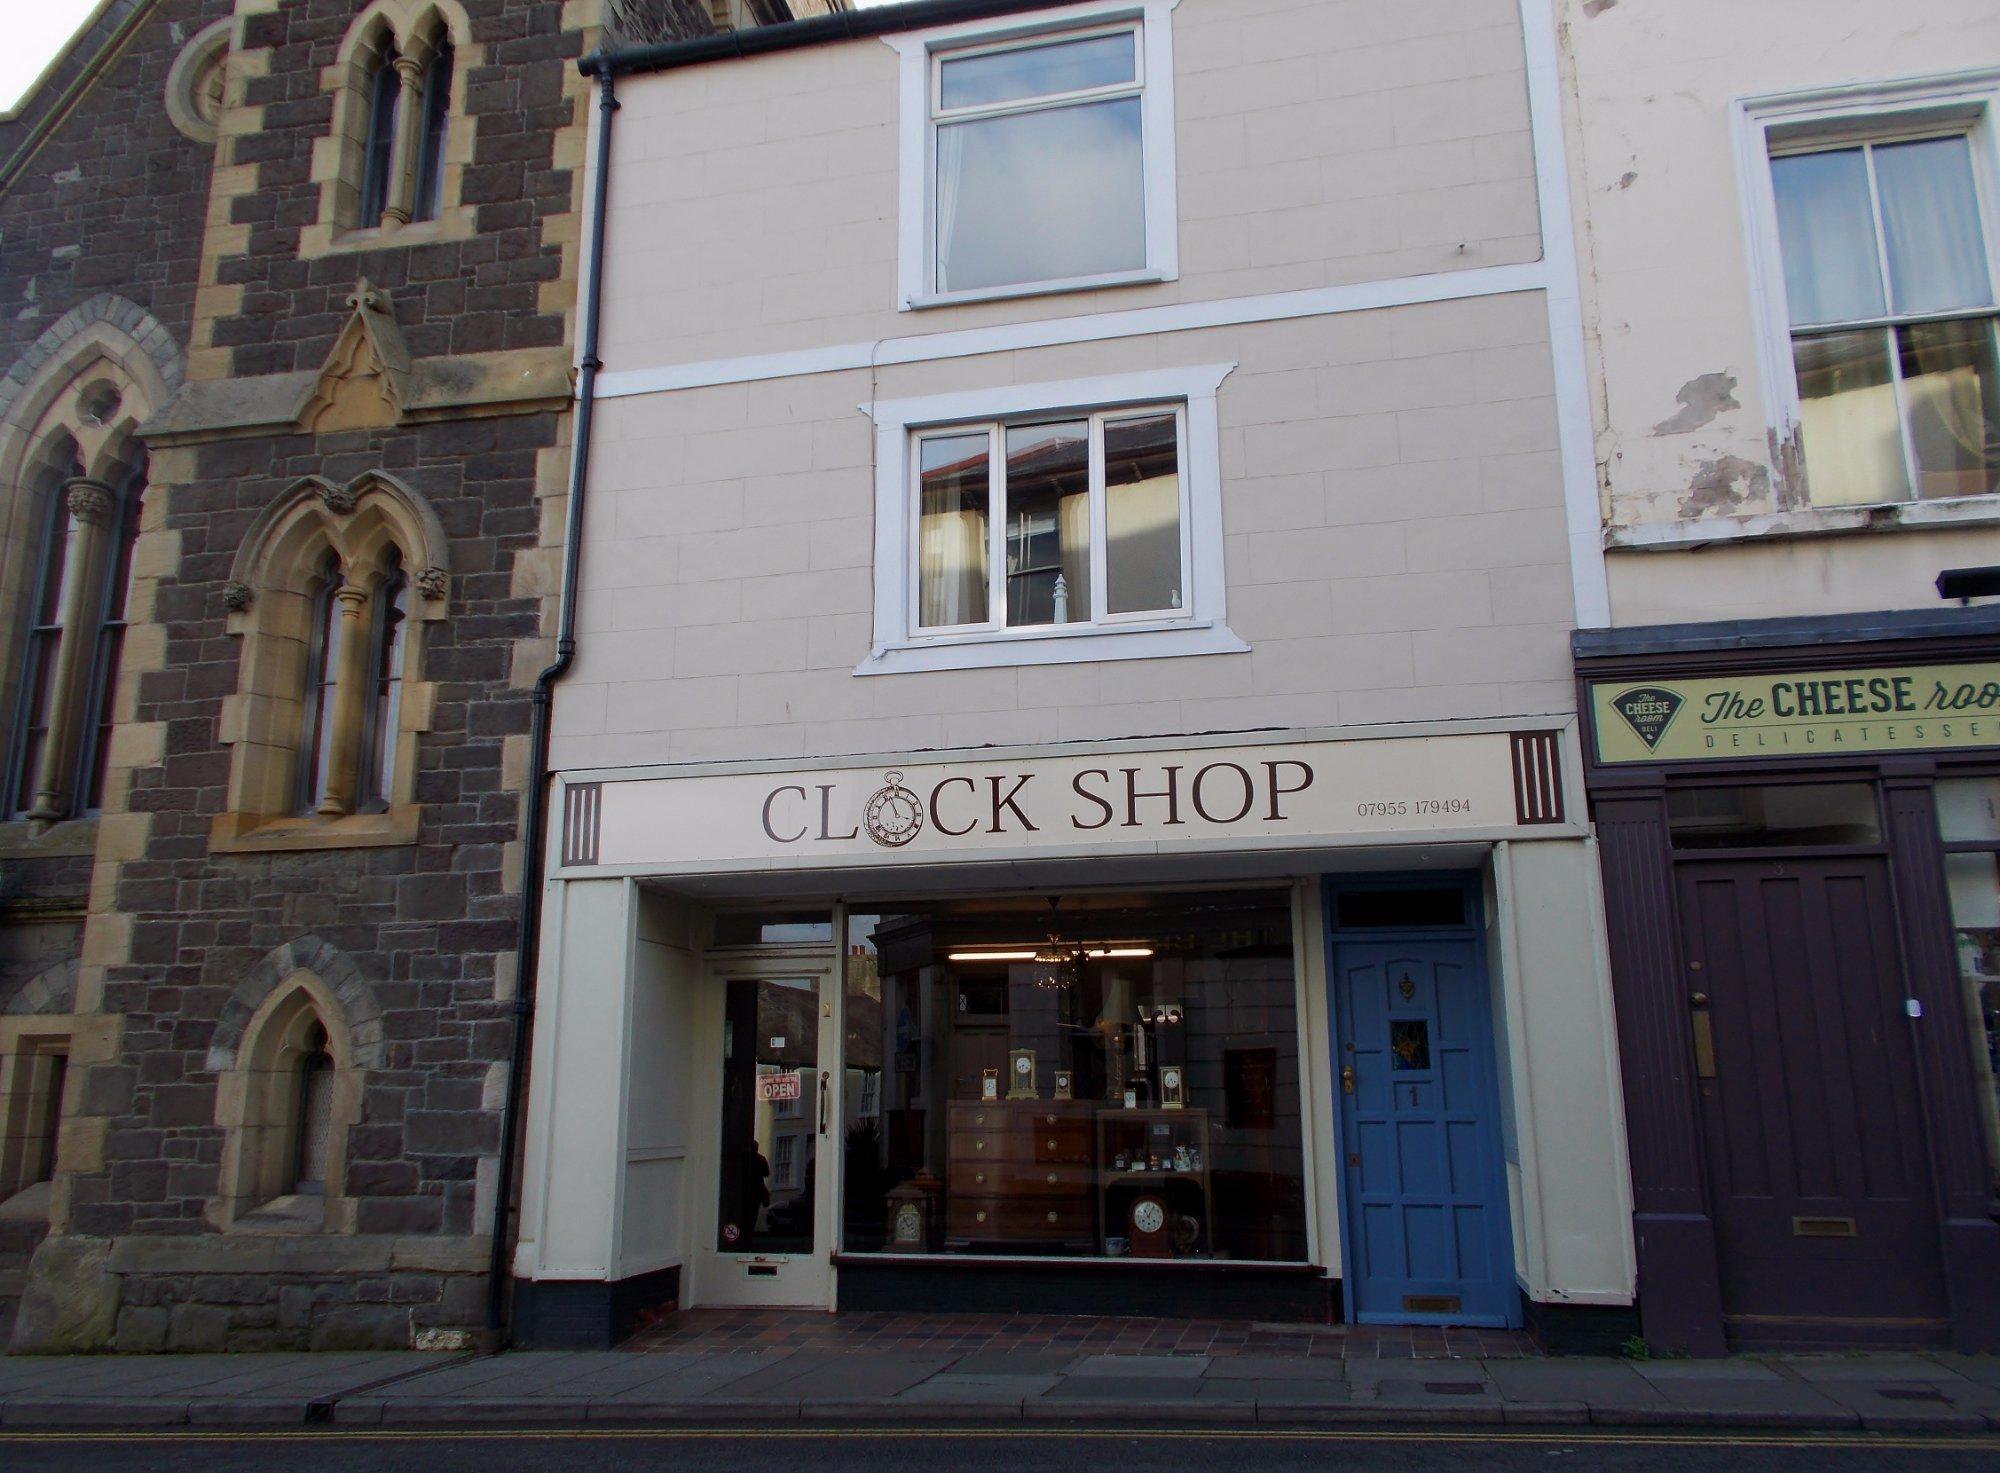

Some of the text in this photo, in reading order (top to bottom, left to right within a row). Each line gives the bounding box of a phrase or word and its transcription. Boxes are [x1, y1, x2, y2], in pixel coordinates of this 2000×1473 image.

[1625, 701, 1670, 714] CHEESE
[1638, 694, 1656, 703] The
[1701, 676, 2000, 723] The CHEESE roo
[1634, 714, 1664, 723] room
[1706, 721, 2000, 748] DELICATESSE
[1070, 760, 1314, 829] SHOP
[1357, 799, 1471, 817] 07955 179494
[764, 1083, 795, 1097] OPEN
[1410, 1086, 1419, 1106] 1
